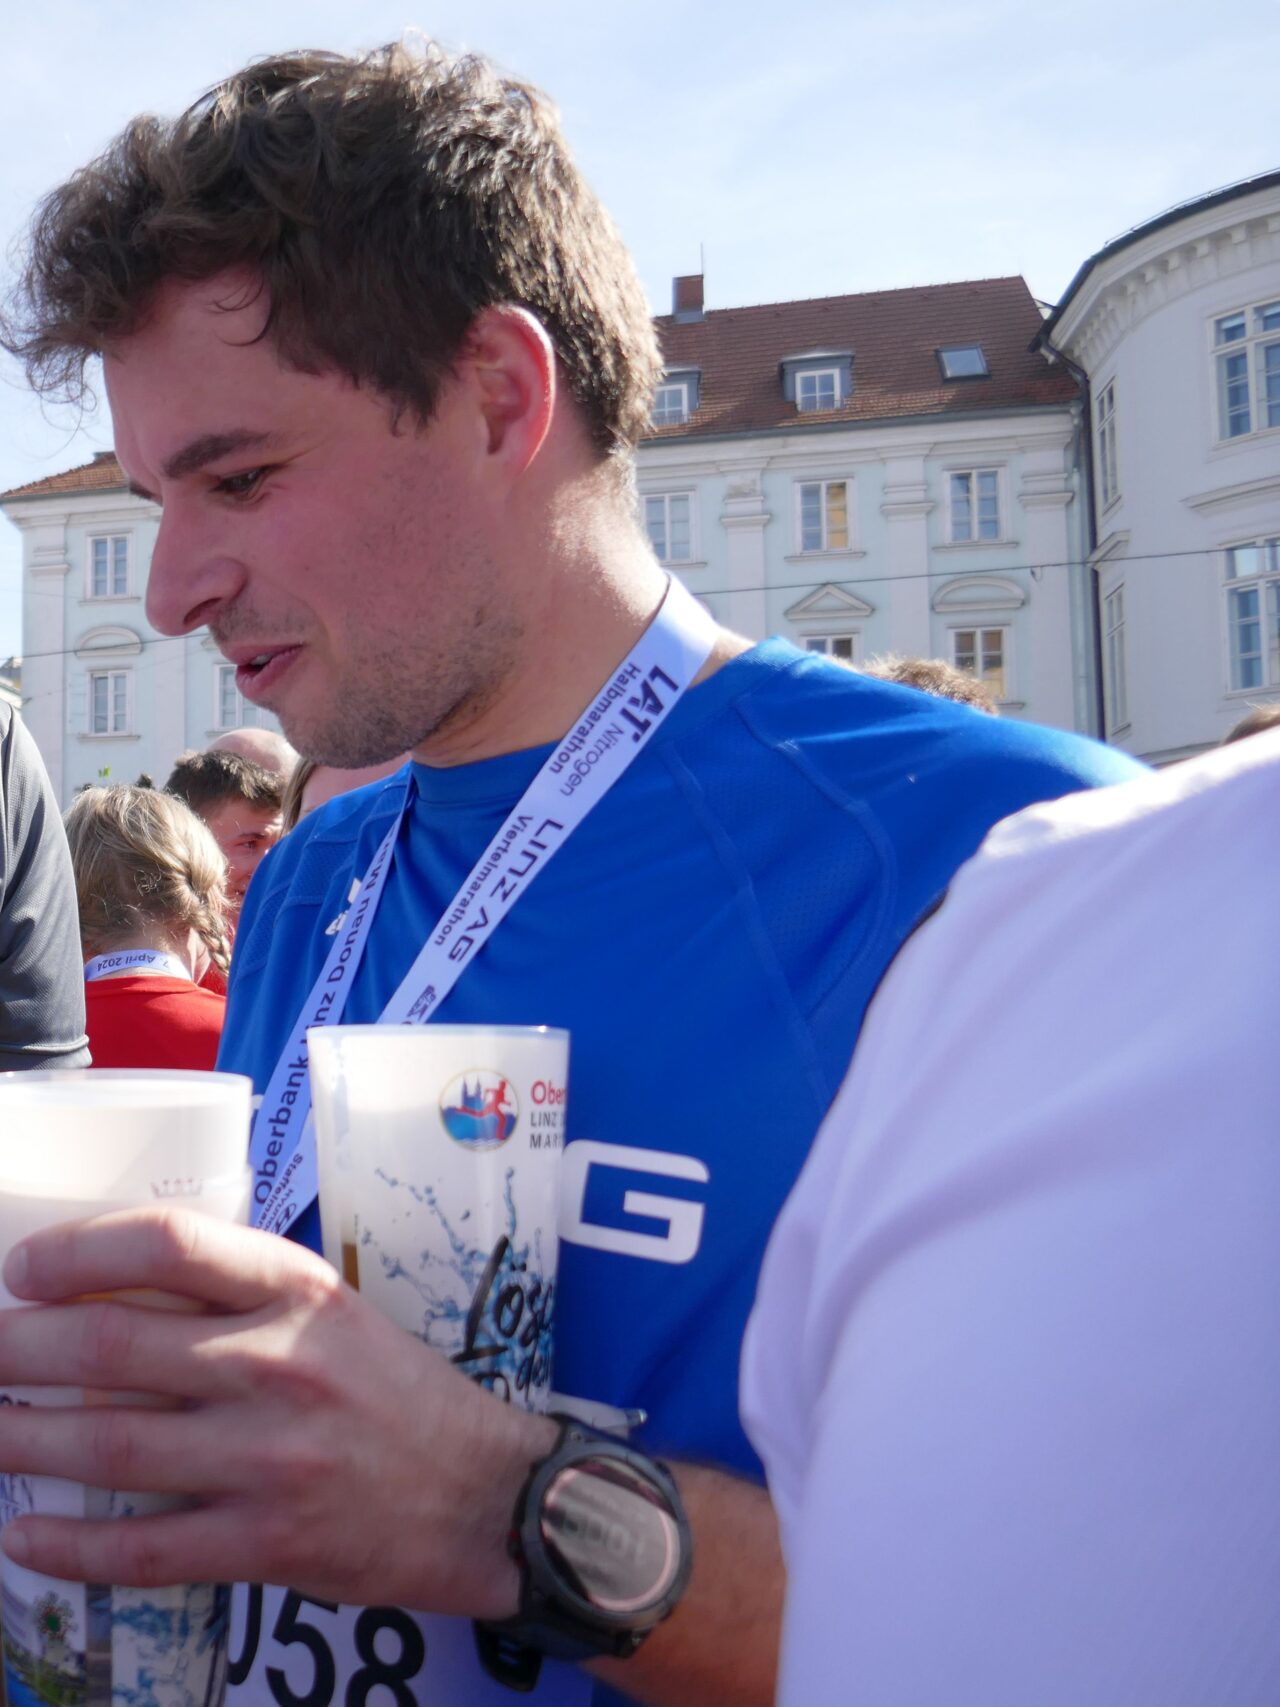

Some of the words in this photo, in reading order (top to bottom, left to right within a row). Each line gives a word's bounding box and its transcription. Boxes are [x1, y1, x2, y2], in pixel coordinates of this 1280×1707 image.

[549, 662, 641, 775] Halbmarathon
[560, 723, 625, 797] Nitrogen
[434, 814, 534, 946] Viertelmarathon
[97, 957, 122, 972] 2024
[123, 953, 158, 964] April
[448, 906, 489, 963] AG
[254, 1055, 308, 1205] Oberbank
[327, 897, 370, 983] Donau
[530, 1111, 557, 1128] LINZ
